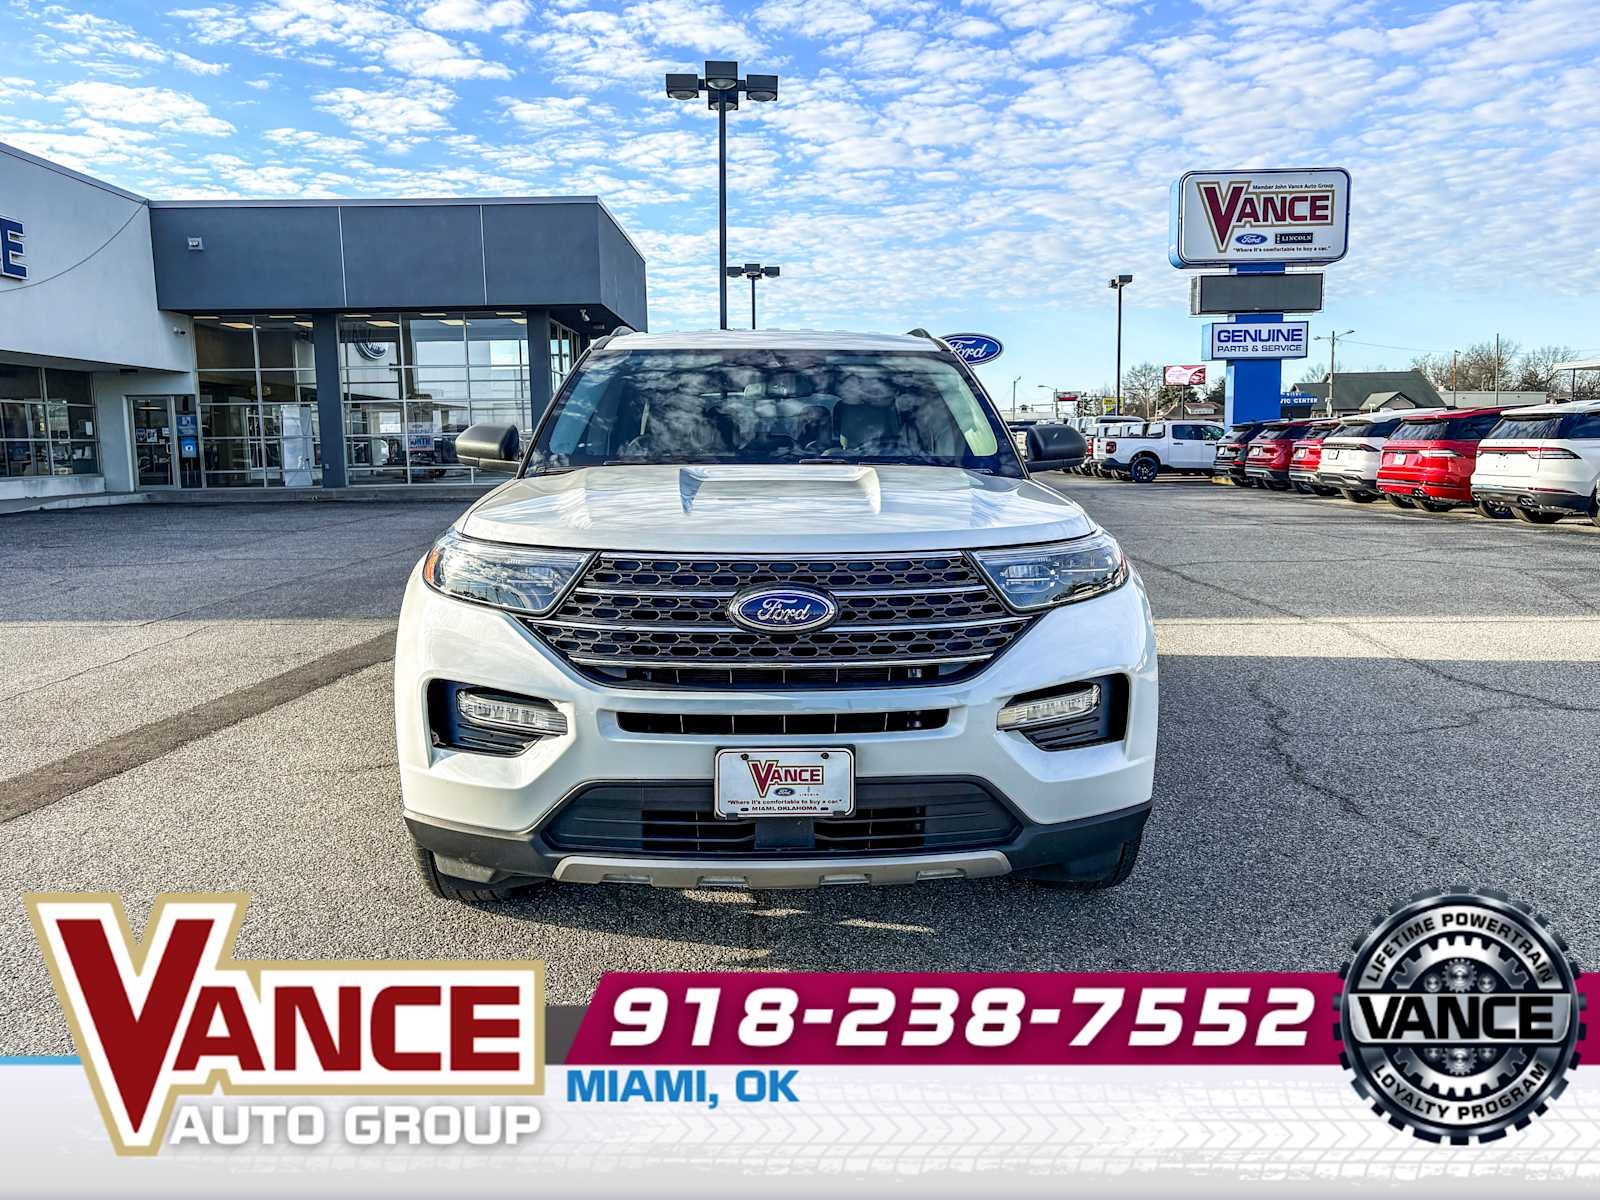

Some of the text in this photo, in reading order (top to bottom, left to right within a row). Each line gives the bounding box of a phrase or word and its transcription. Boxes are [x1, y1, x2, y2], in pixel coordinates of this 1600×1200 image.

[1201, 185, 1331, 249] VANCE
[1240, 233, 1262, 244] Ford
[1217, 328, 1303, 343] GENUINE
[950, 339, 988, 359] Ford
[1217, 345, 1249, 353] PARTS
[1261, 344, 1302, 352] SERVICE
[757, 598, 811, 621] Ford
[750, 762, 822, 796] VANCE
